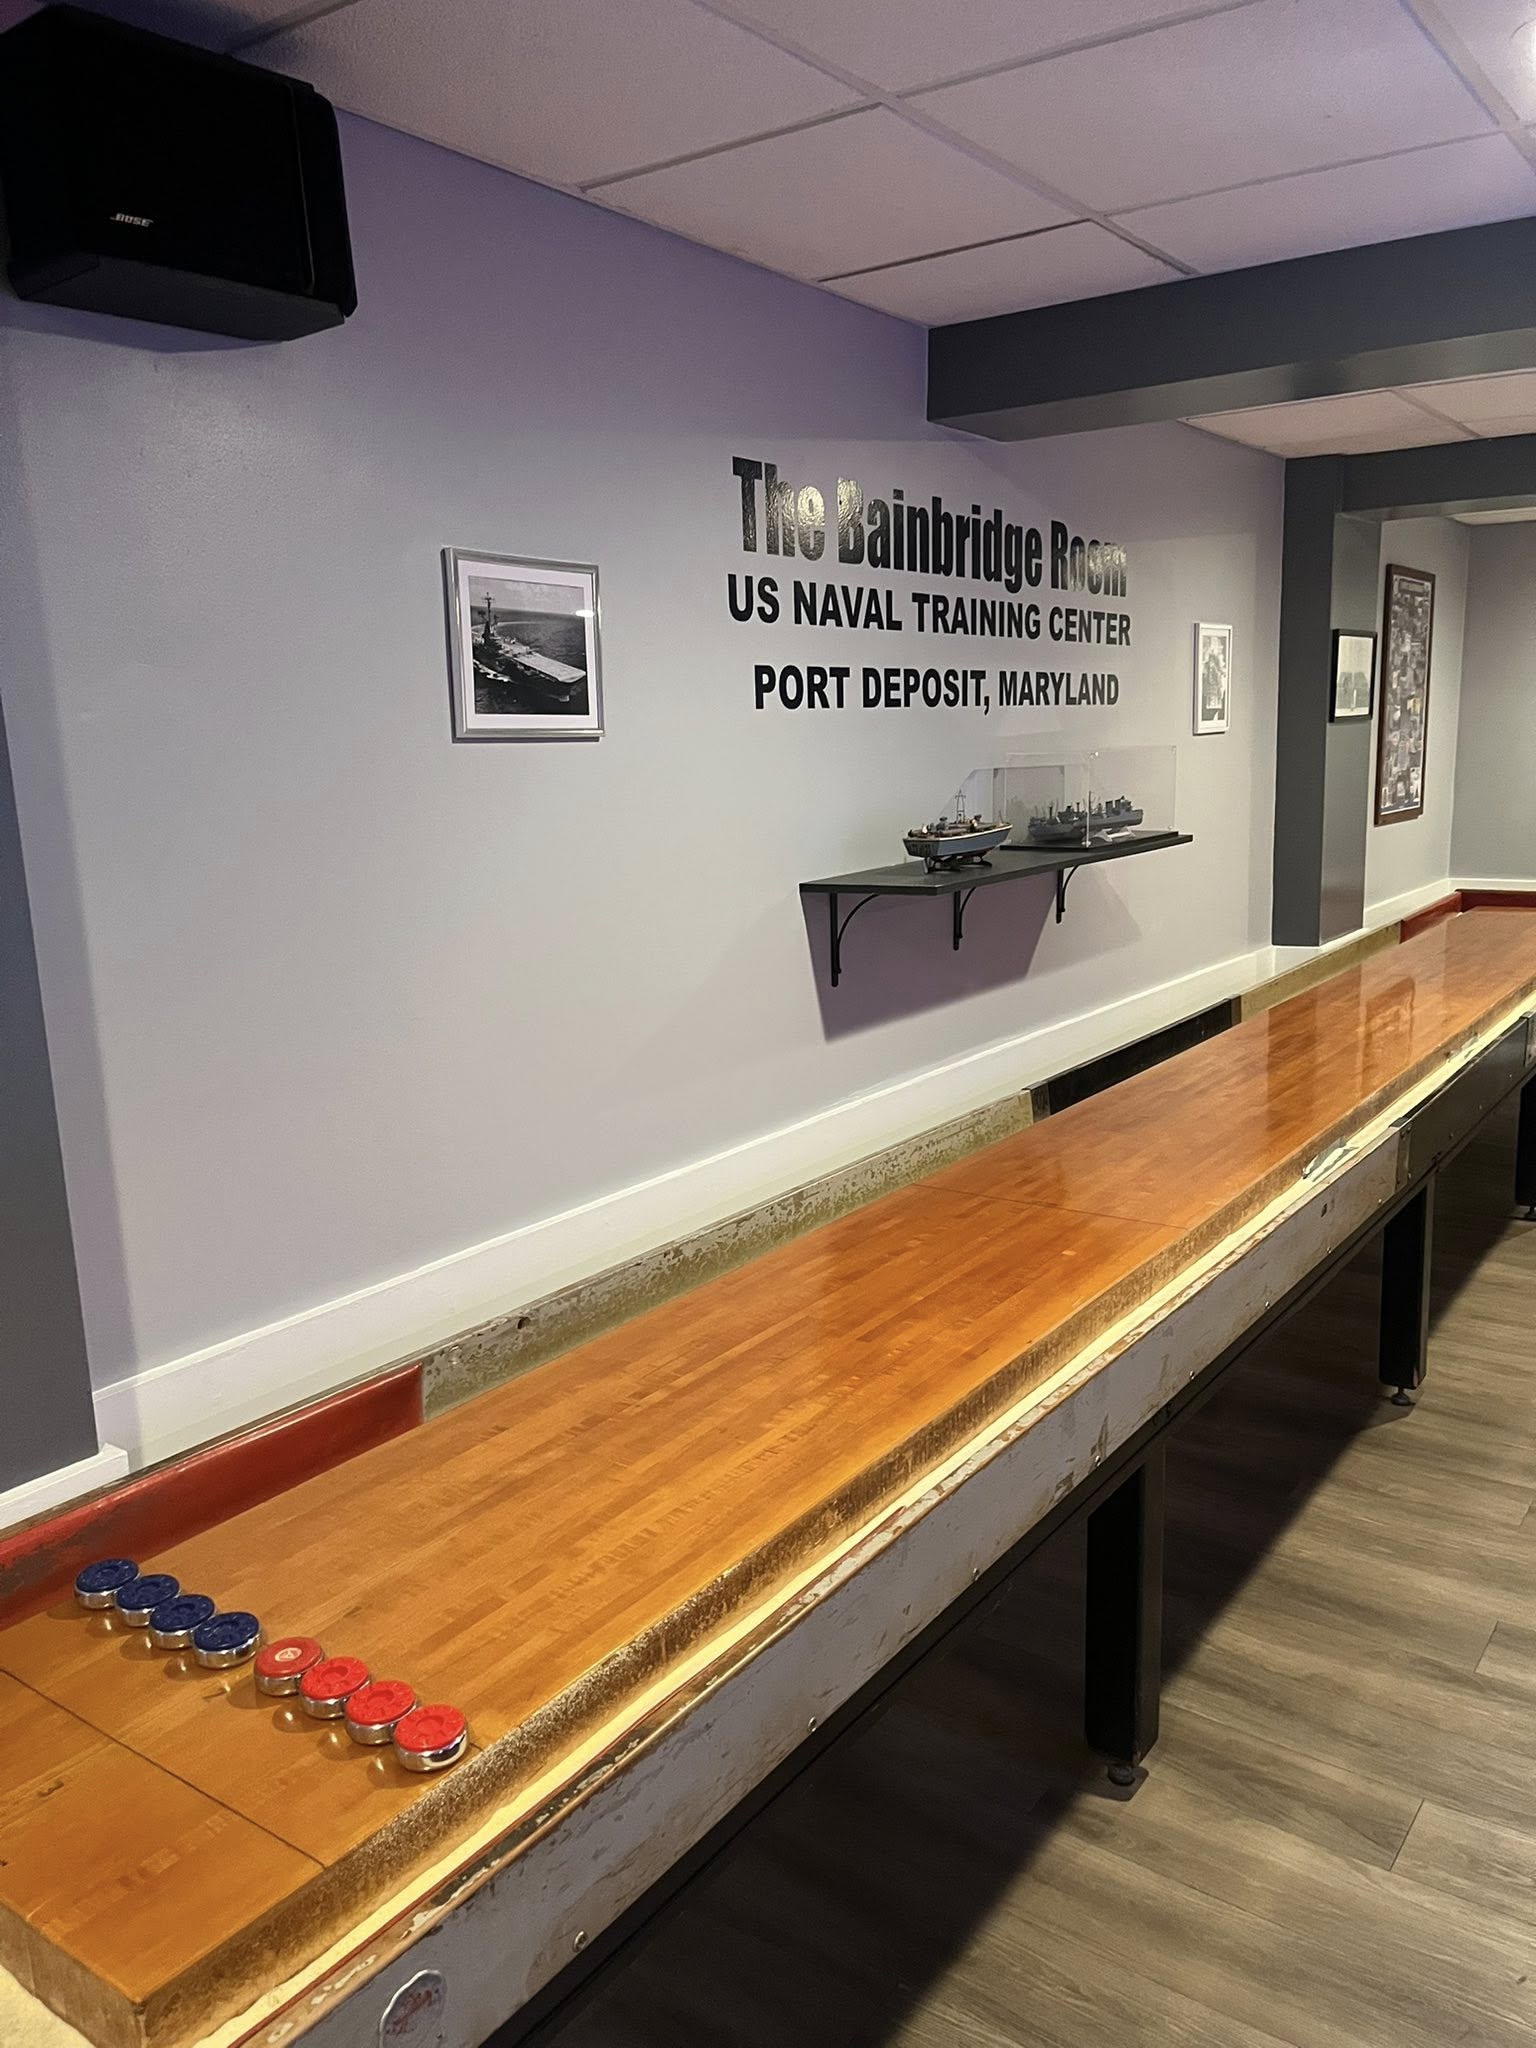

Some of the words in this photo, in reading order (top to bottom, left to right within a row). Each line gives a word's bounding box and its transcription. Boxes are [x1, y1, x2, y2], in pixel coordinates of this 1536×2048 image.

[732, 456, 826, 561] The
[837, 477, 1043, 594] Bainbridge
[1050, 520, 1128, 598] Room
[727, 574, 780, 624] US
[793, 580, 903, 631] NAVAL
[912, 592, 1041, 640] TRAINING
[1049, 607, 1131, 647] CENTER
[754, 665, 850, 710] PORT
[862, 667, 990, 716] DEPOSIT,
[999, 671, 1120, 707] MARYLAND
